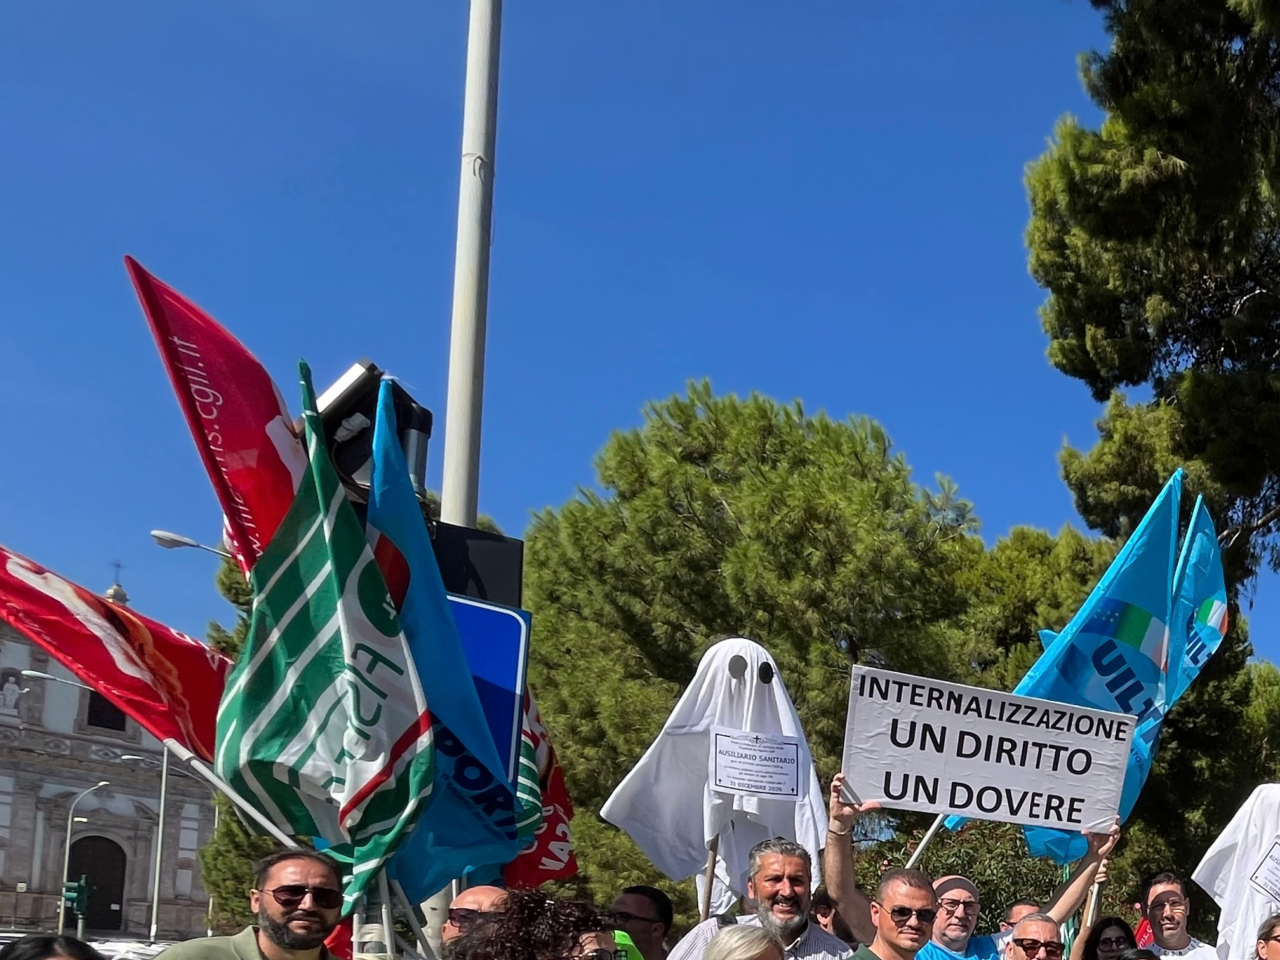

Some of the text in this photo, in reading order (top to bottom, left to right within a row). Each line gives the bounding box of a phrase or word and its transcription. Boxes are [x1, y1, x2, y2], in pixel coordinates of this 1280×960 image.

[858, 674, 1130, 742] INTERNALIZZAZIONE
[718, 749, 757, 761] AUSILIARIO
[759, 755, 796, 765] SANITARIO
[889, 718, 947, 754] UN
[955, 730, 1093, 775] DIRITTO
[737, 781, 767, 791] DICEMBRE
[883, 771, 1086, 824] UN DOVERE
